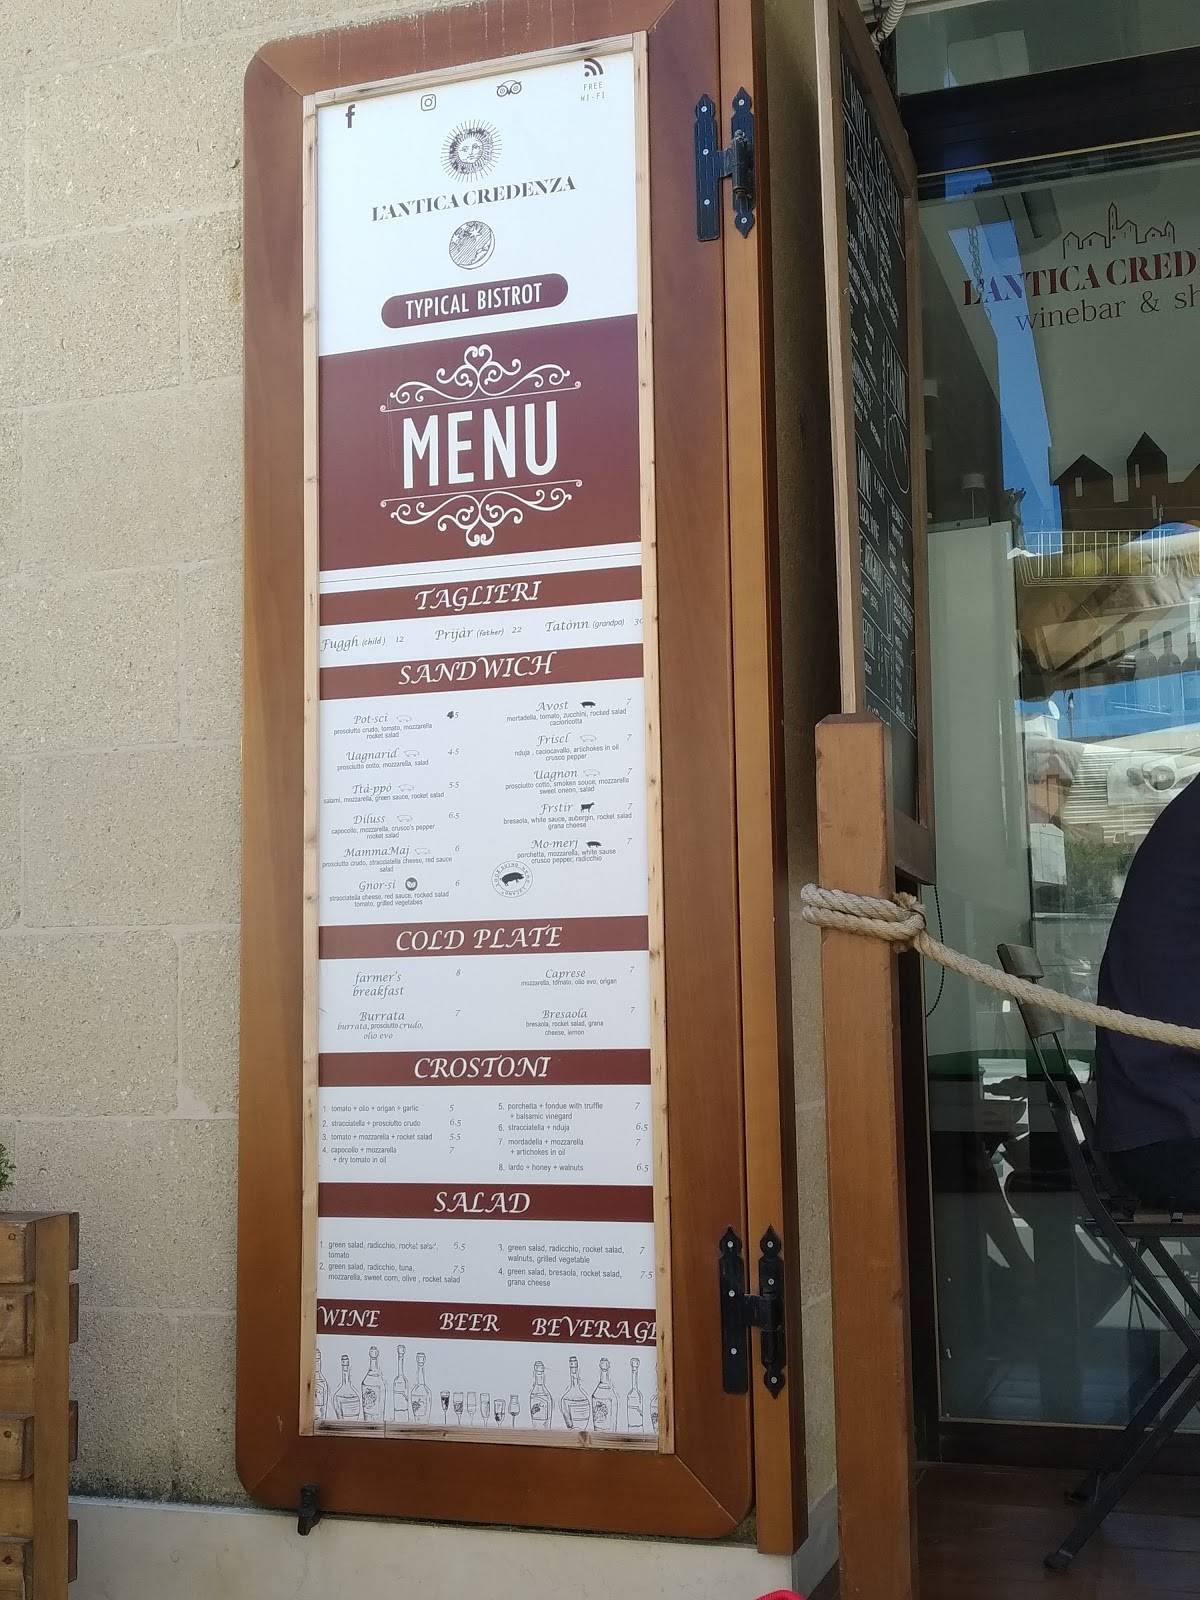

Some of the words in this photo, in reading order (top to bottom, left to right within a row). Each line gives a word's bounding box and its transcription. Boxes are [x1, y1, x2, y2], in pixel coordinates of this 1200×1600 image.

[584, 82, 603, 91] FREE
[581, 91, 604, 102] WI-FI
[371, 193, 459, 222] L'ANTICA
[463, 176, 576, 207] CREDENZA
[1107, 247, 1200, 287] CRED
[405, 292, 469, 320] TYPICAL
[477, 282, 543, 310] BISTROT
[1016, 300, 1126, 332] winebar
[1140, 291, 1160, 313] &
[403, 400, 557, 489] MENU
[414, 580, 543, 612] TAGLIERI
[512, 626, 522, 634] 22
[398, 651, 558, 686] SANDWICH
[536, 701, 568, 712] Avost
[534, 769, 578, 782] Uagnon
[627, 768, 632, 776] 7
[396, 929, 465, 951] COLD
[473, 924, 563, 949] PLATE
[353, 971, 402, 986] farmer's
[545, 969, 586, 981] Caprese
[352, 986, 404, 1000] breakfast
[359, 1010, 405, 1022] Burrata
[542, 1008, 588, 1019] Bresaola
[630, 1006, 635, 1014] 7
[414, 1054, 551, 1079] CROSTONI
[377, 1105, 395, 1113] origan
[402, 1105, 419, 1113] garlic
[449, 1104, 454, 1112] 5
[508, 1102, 537, 1111] porchetta
[545, 1102, 567, 1110] fondue
[584, 1102, 603, 1110] truffle
[635, 1102, 640, 1110] 7
[552, 1124, 570, 1132] nduja
[635, 1123, 648, 1131] 6.5
[635, 1139, 640, 1147] 7
[338, 1156, 348, 1164] dry
[532, 1164, 550, 1172] honey
[637, 1164, 649, 1172] 6.5
[433, 1191, 530, 1213] SALAD
[508, 1245, 526, 1253] green
[583, 1245, 603, 1253] rocket
[639, 1246, 645, 1255] 7
[537, 1255, 556, 1263] grilled
[559, 1256, 590, 1264] vegetable
[328, 1264, 345, 1272] green
[508, 1268, 526, 1277] green
[580, 1270, 600, 1278] rocket
[508, 1279, 525, 1287] grana
[527, 1278, 550, 1286] cheese
[318, 1306, 380, 1328] WINE
[439, 1312, 500, 1332] BEER
